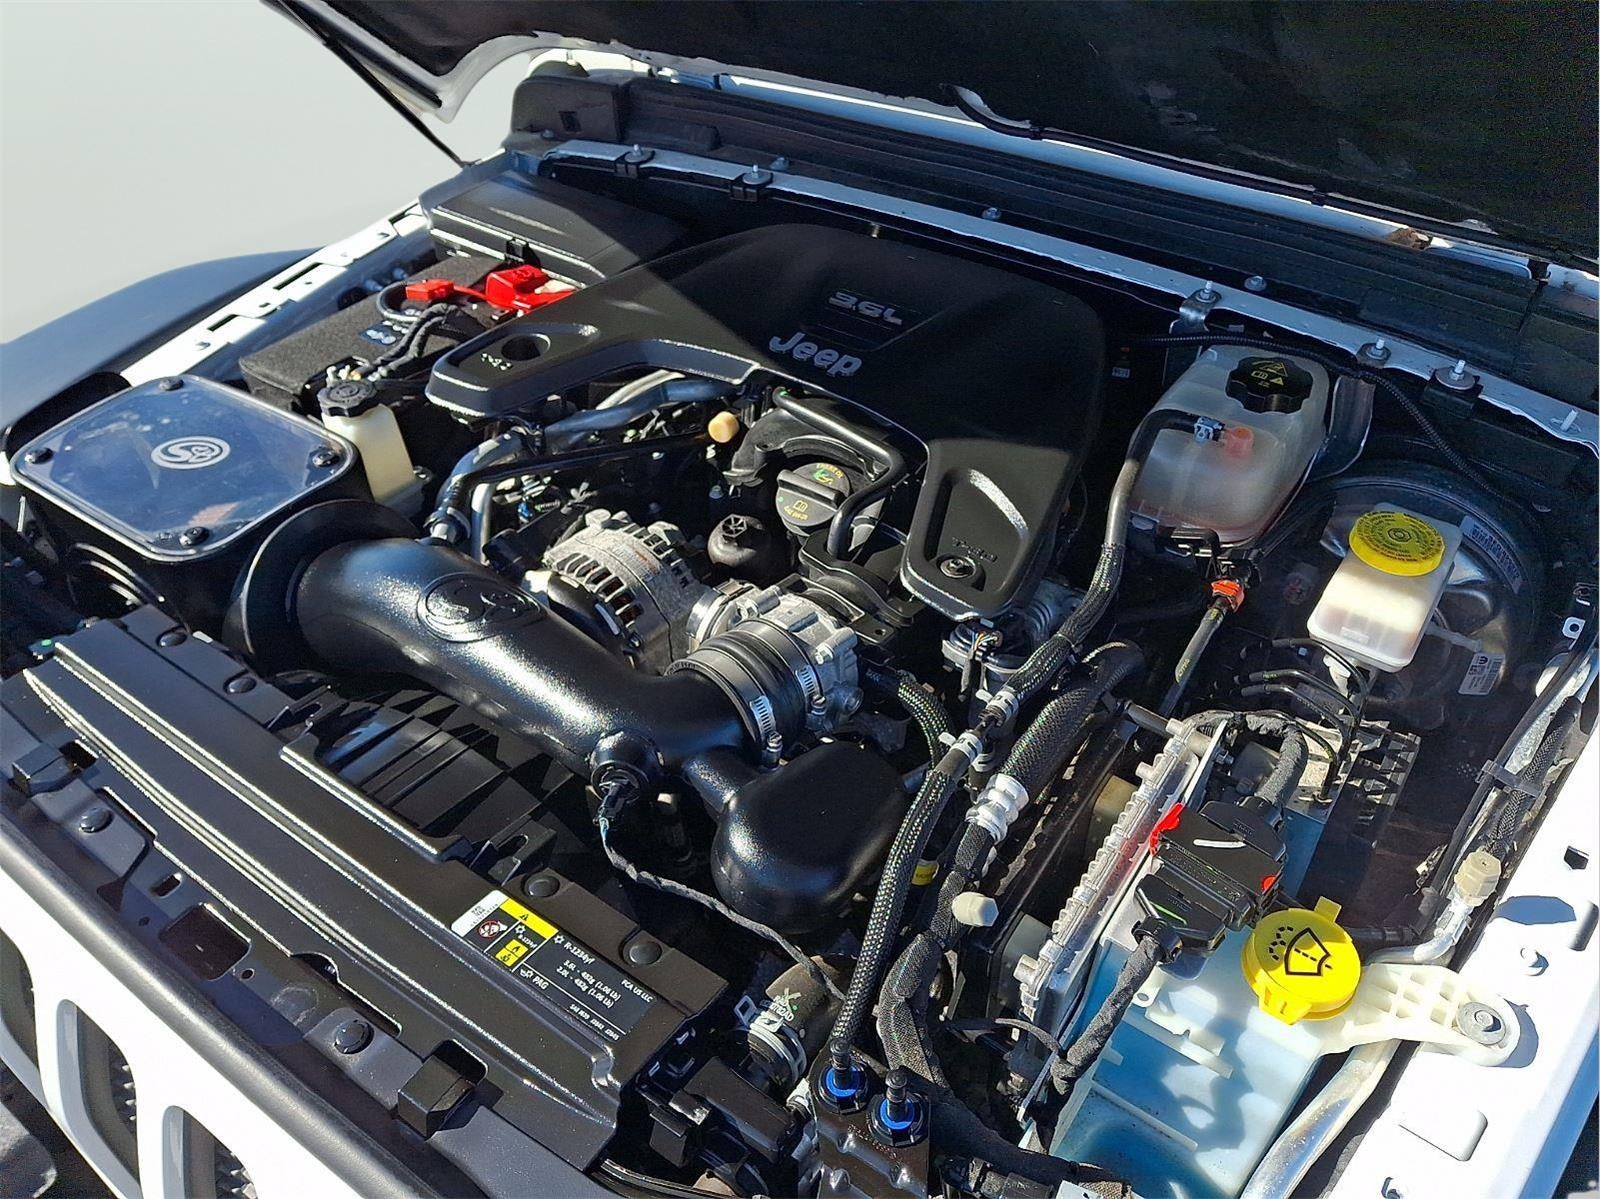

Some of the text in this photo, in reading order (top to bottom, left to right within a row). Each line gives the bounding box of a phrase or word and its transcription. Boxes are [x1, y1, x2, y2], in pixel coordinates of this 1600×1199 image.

[828, 290, 903, 326] 3.6L
[768, 331, 863, 378] Jeep
[563, 941, 596, 965] R-1234yf
[563, 959, 577, 971] 3.6L
[532, 975, 550, 990] PAG
[620, 978, 634, 991] FCA
[641, 992, 654, 1004] LLC
